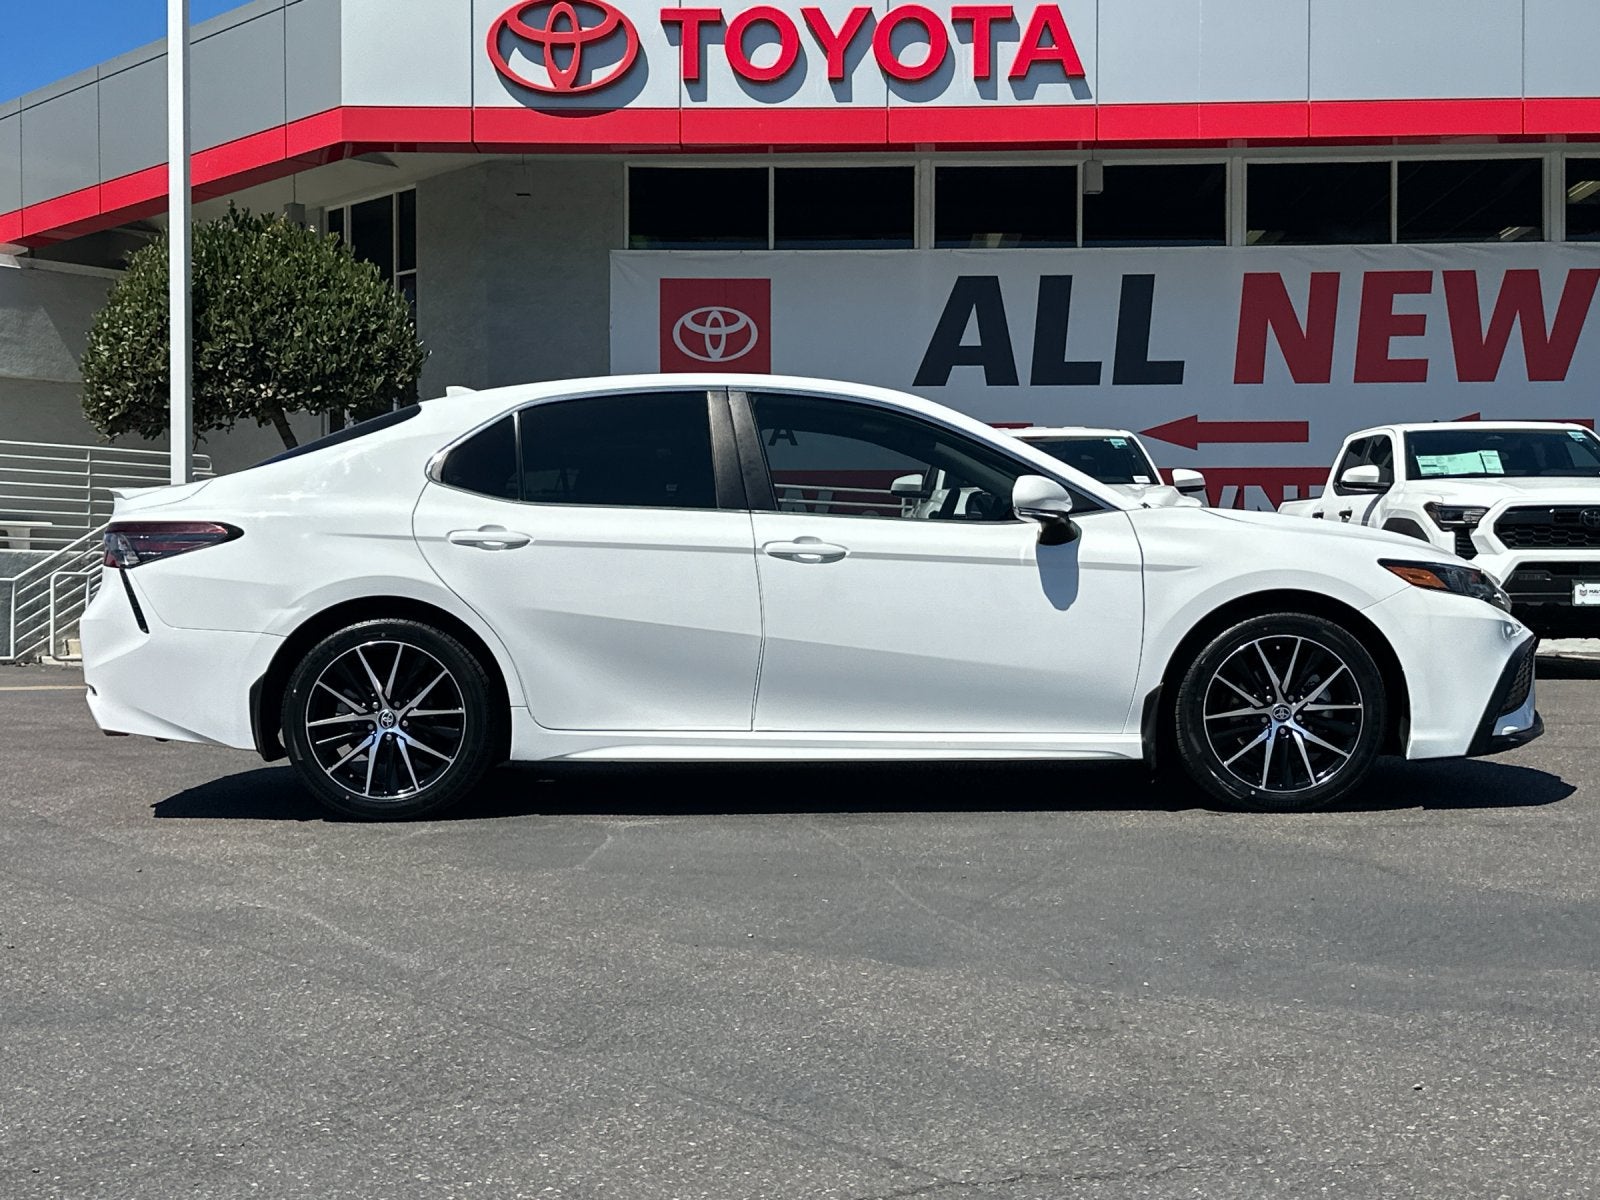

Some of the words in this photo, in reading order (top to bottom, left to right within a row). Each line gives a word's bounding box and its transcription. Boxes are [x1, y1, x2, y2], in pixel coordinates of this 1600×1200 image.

[661, 5, 1083, 80] TOYOTA
[912, 274, 1184, 386] ALL
[1235, 269, 1600, 384] NEW
